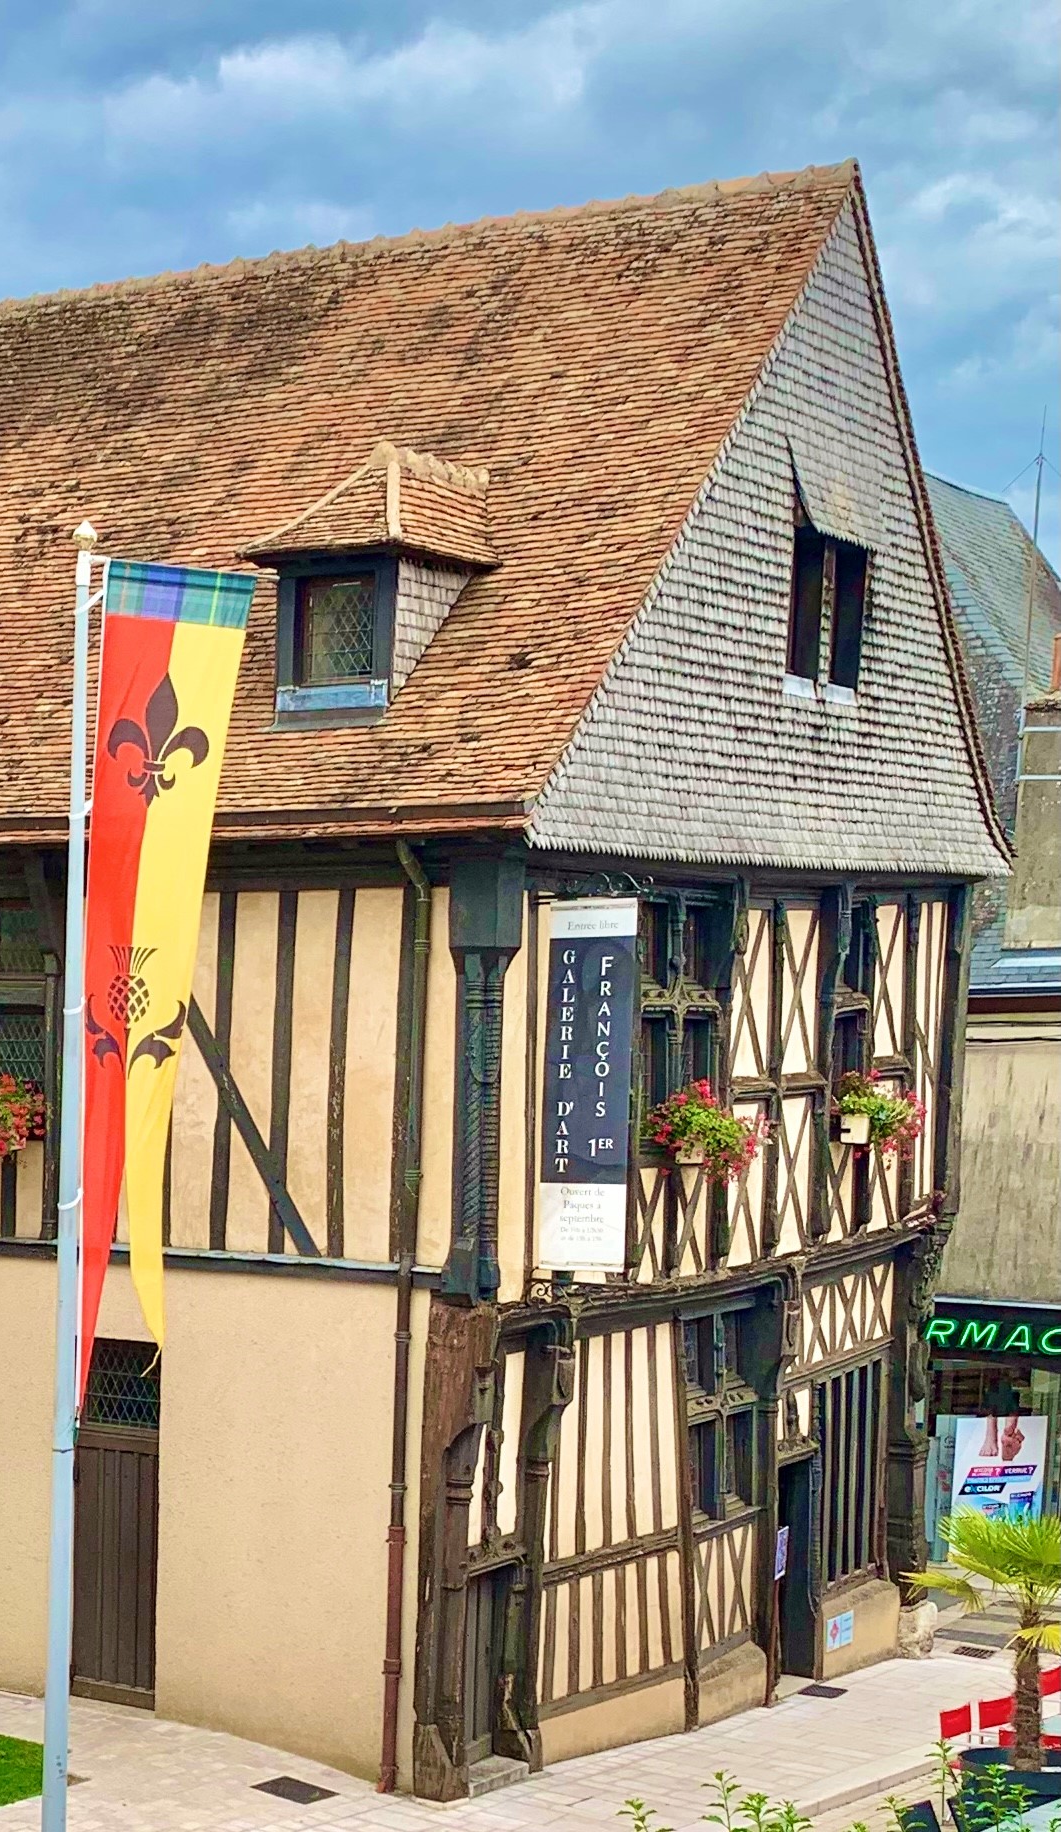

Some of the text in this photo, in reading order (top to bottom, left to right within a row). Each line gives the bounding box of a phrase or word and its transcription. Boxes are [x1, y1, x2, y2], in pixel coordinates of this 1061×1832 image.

[599, 919, 619, 930] libre
[554, 949, 576, 1173] GALERIE D'ART
[587, 956, 614, 1157] FRANÇOIS 1ER
[560, 1186, 605, 1196] Ouvert de
[559, 1213, 604, 1224] septembre
